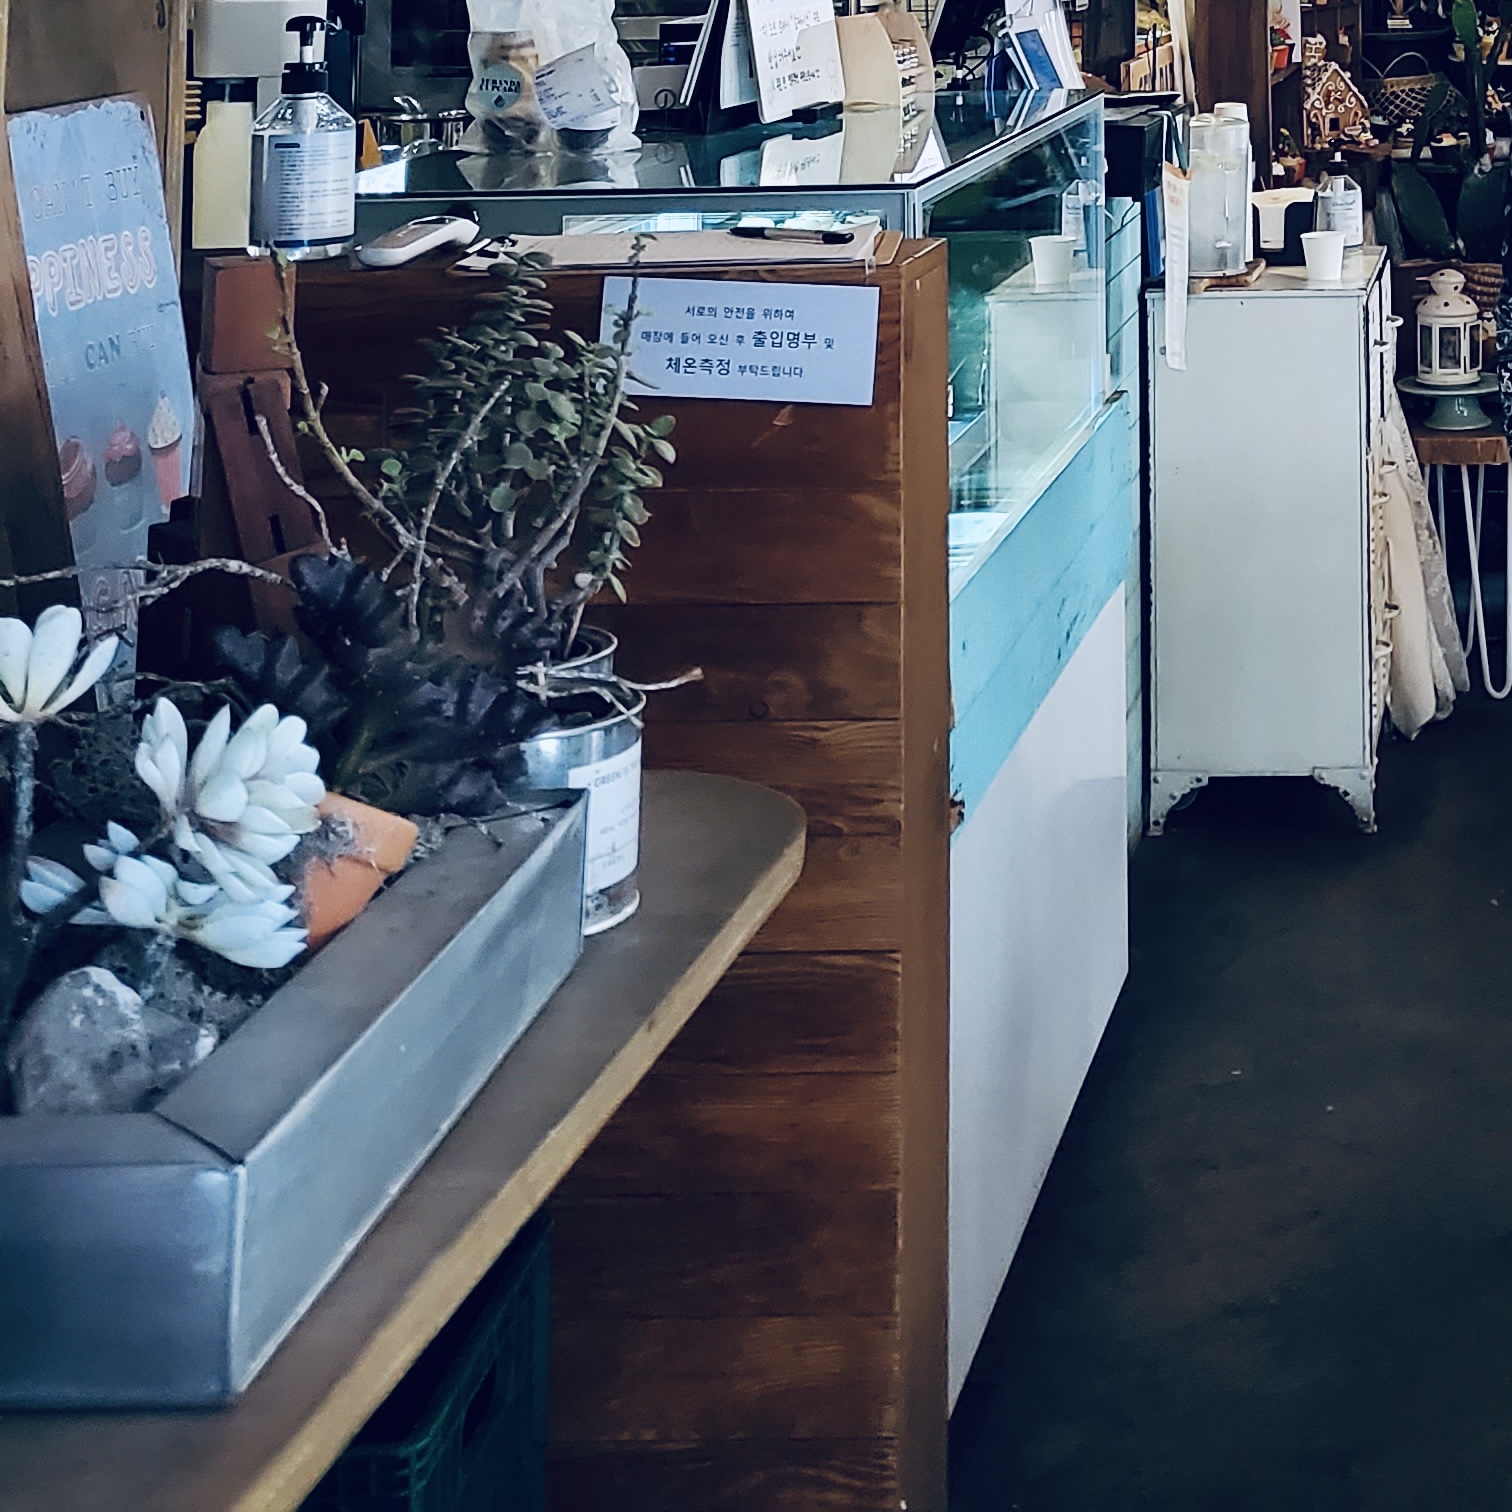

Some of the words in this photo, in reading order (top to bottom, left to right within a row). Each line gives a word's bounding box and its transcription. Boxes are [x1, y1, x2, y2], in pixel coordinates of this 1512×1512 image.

[104, 164, 141, 204] BUY
[685, 305, 717, 319] 서로의
[723, 306, 756, 320] 안전을
[762, 308, 795, 321] 위하여
[641, 330, 674, 344] 매장에
[681, 332, 701, 345] 들어
[706, 333, 729, 346] 오신
[736, 334, 746, 346] 후
[752, 330, 818, 349] 출입명부
[824, 337, 834, 349] 및
[84, 335, 121, 372] CAN
[665, 356, 731, 376] 체온측정
